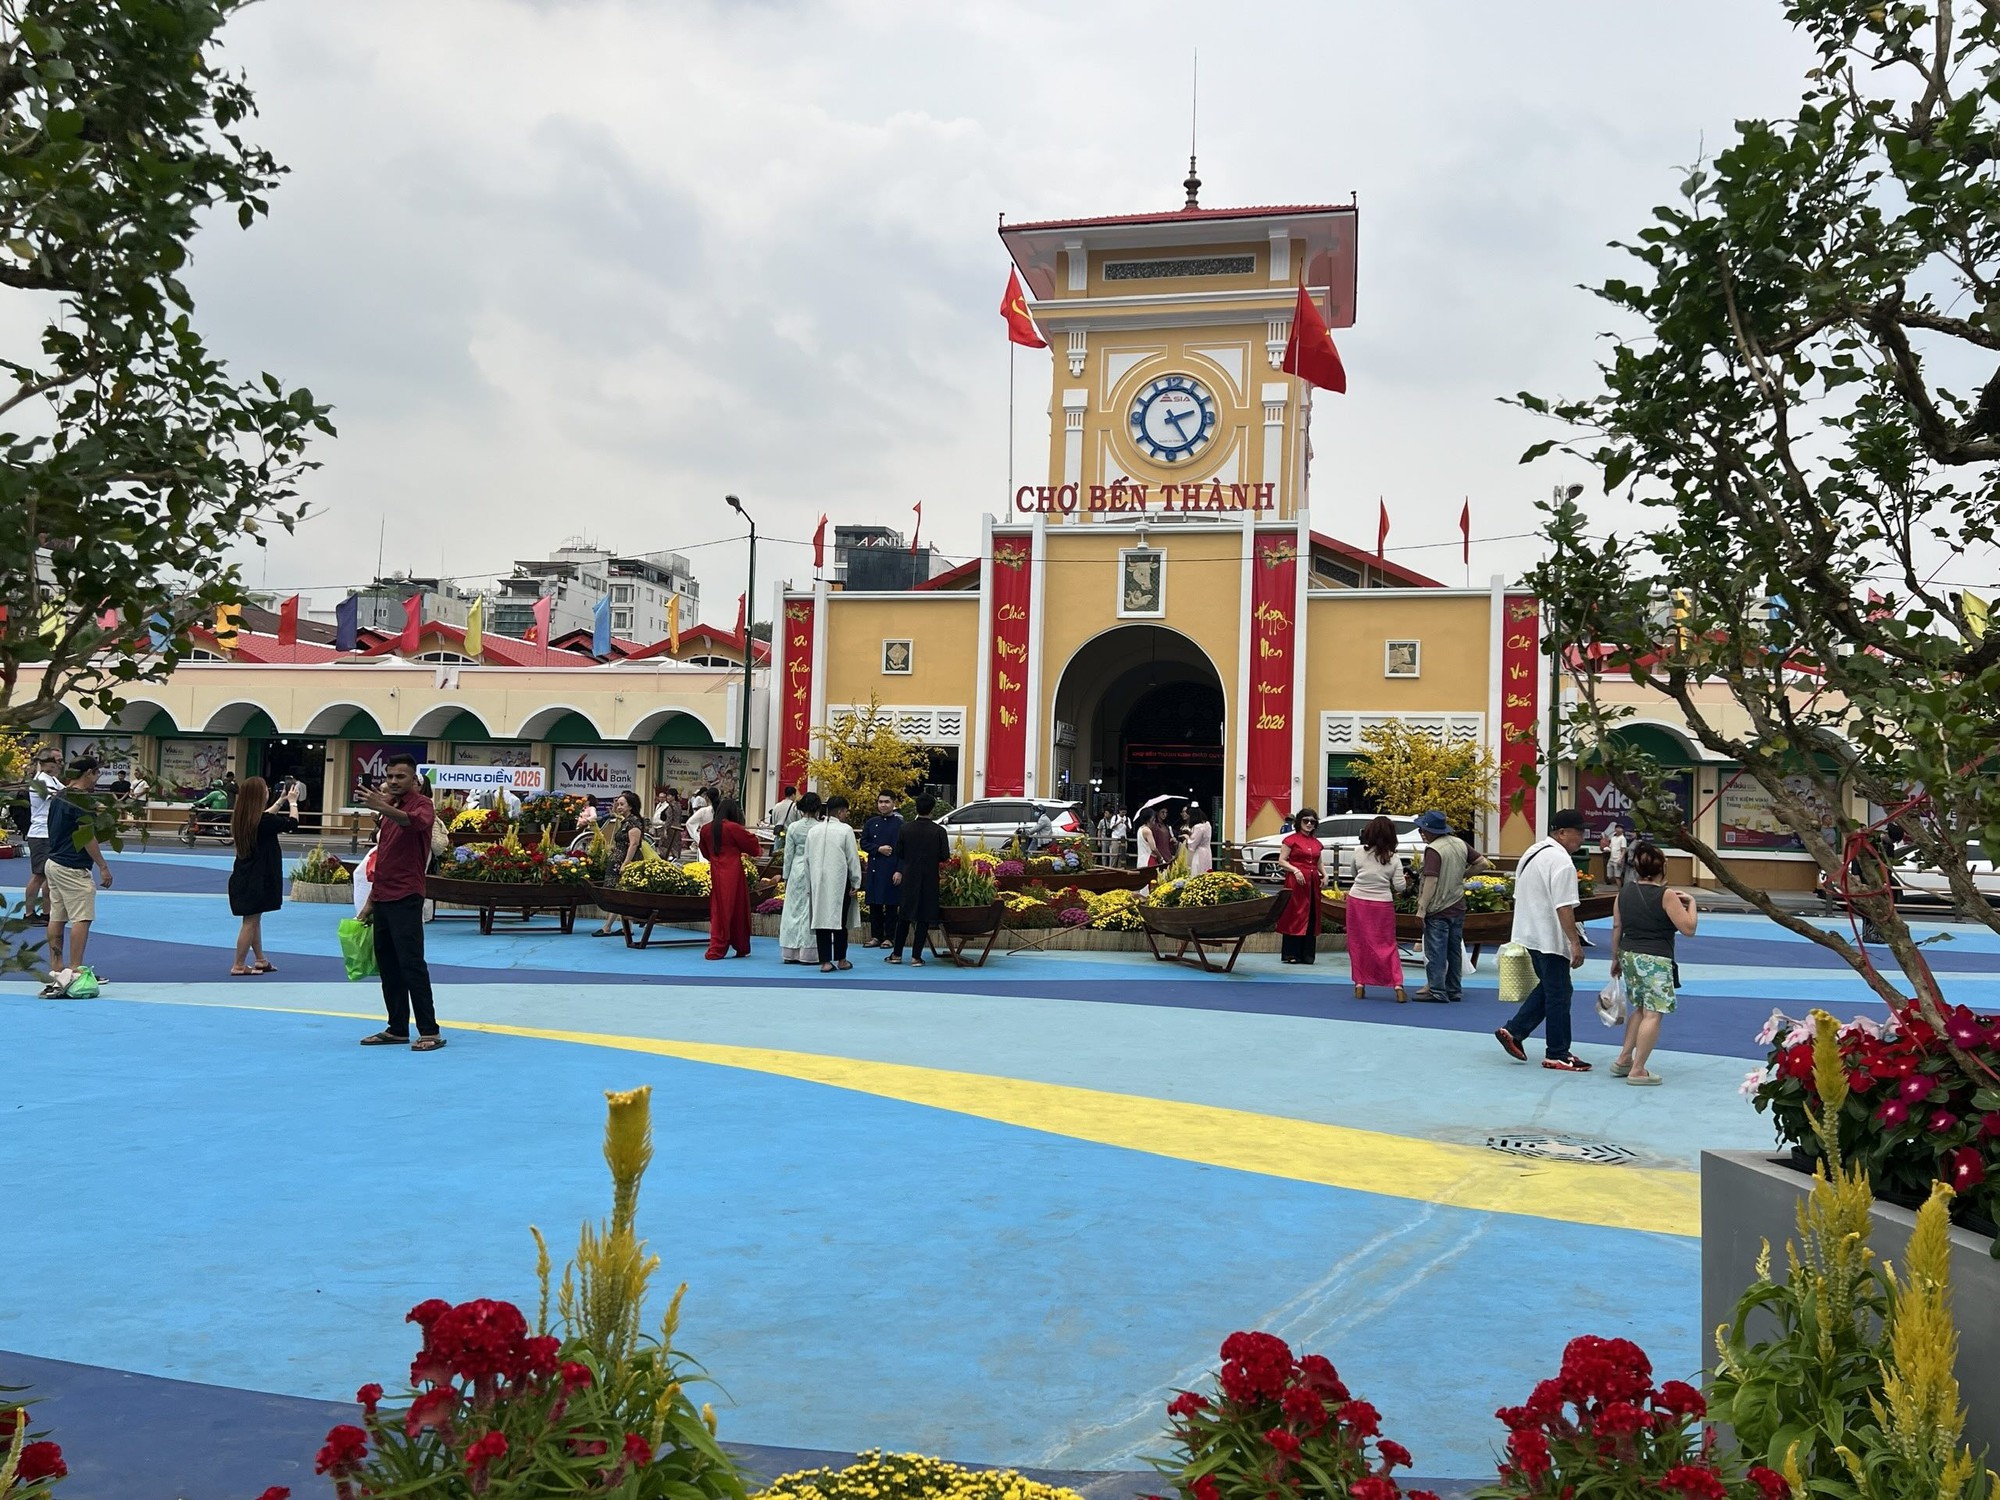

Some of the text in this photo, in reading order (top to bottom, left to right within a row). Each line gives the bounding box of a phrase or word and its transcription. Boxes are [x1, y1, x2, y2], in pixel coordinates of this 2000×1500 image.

[1166, 376, 1183, 389] 12
[1016, 475, 1276, 516] CHỢ BẾN THÀNH
[998, 603, 1026, 620] Chúc
[1254, 600, 1293, 635] Happy
[1256, 714, 1286, 730] 2026
[358, 749, 388, 777] Vik
[561, 753, 609, 781] Vikki
[440, 769, 541, 787] KHANG ĐIỀN 2026
